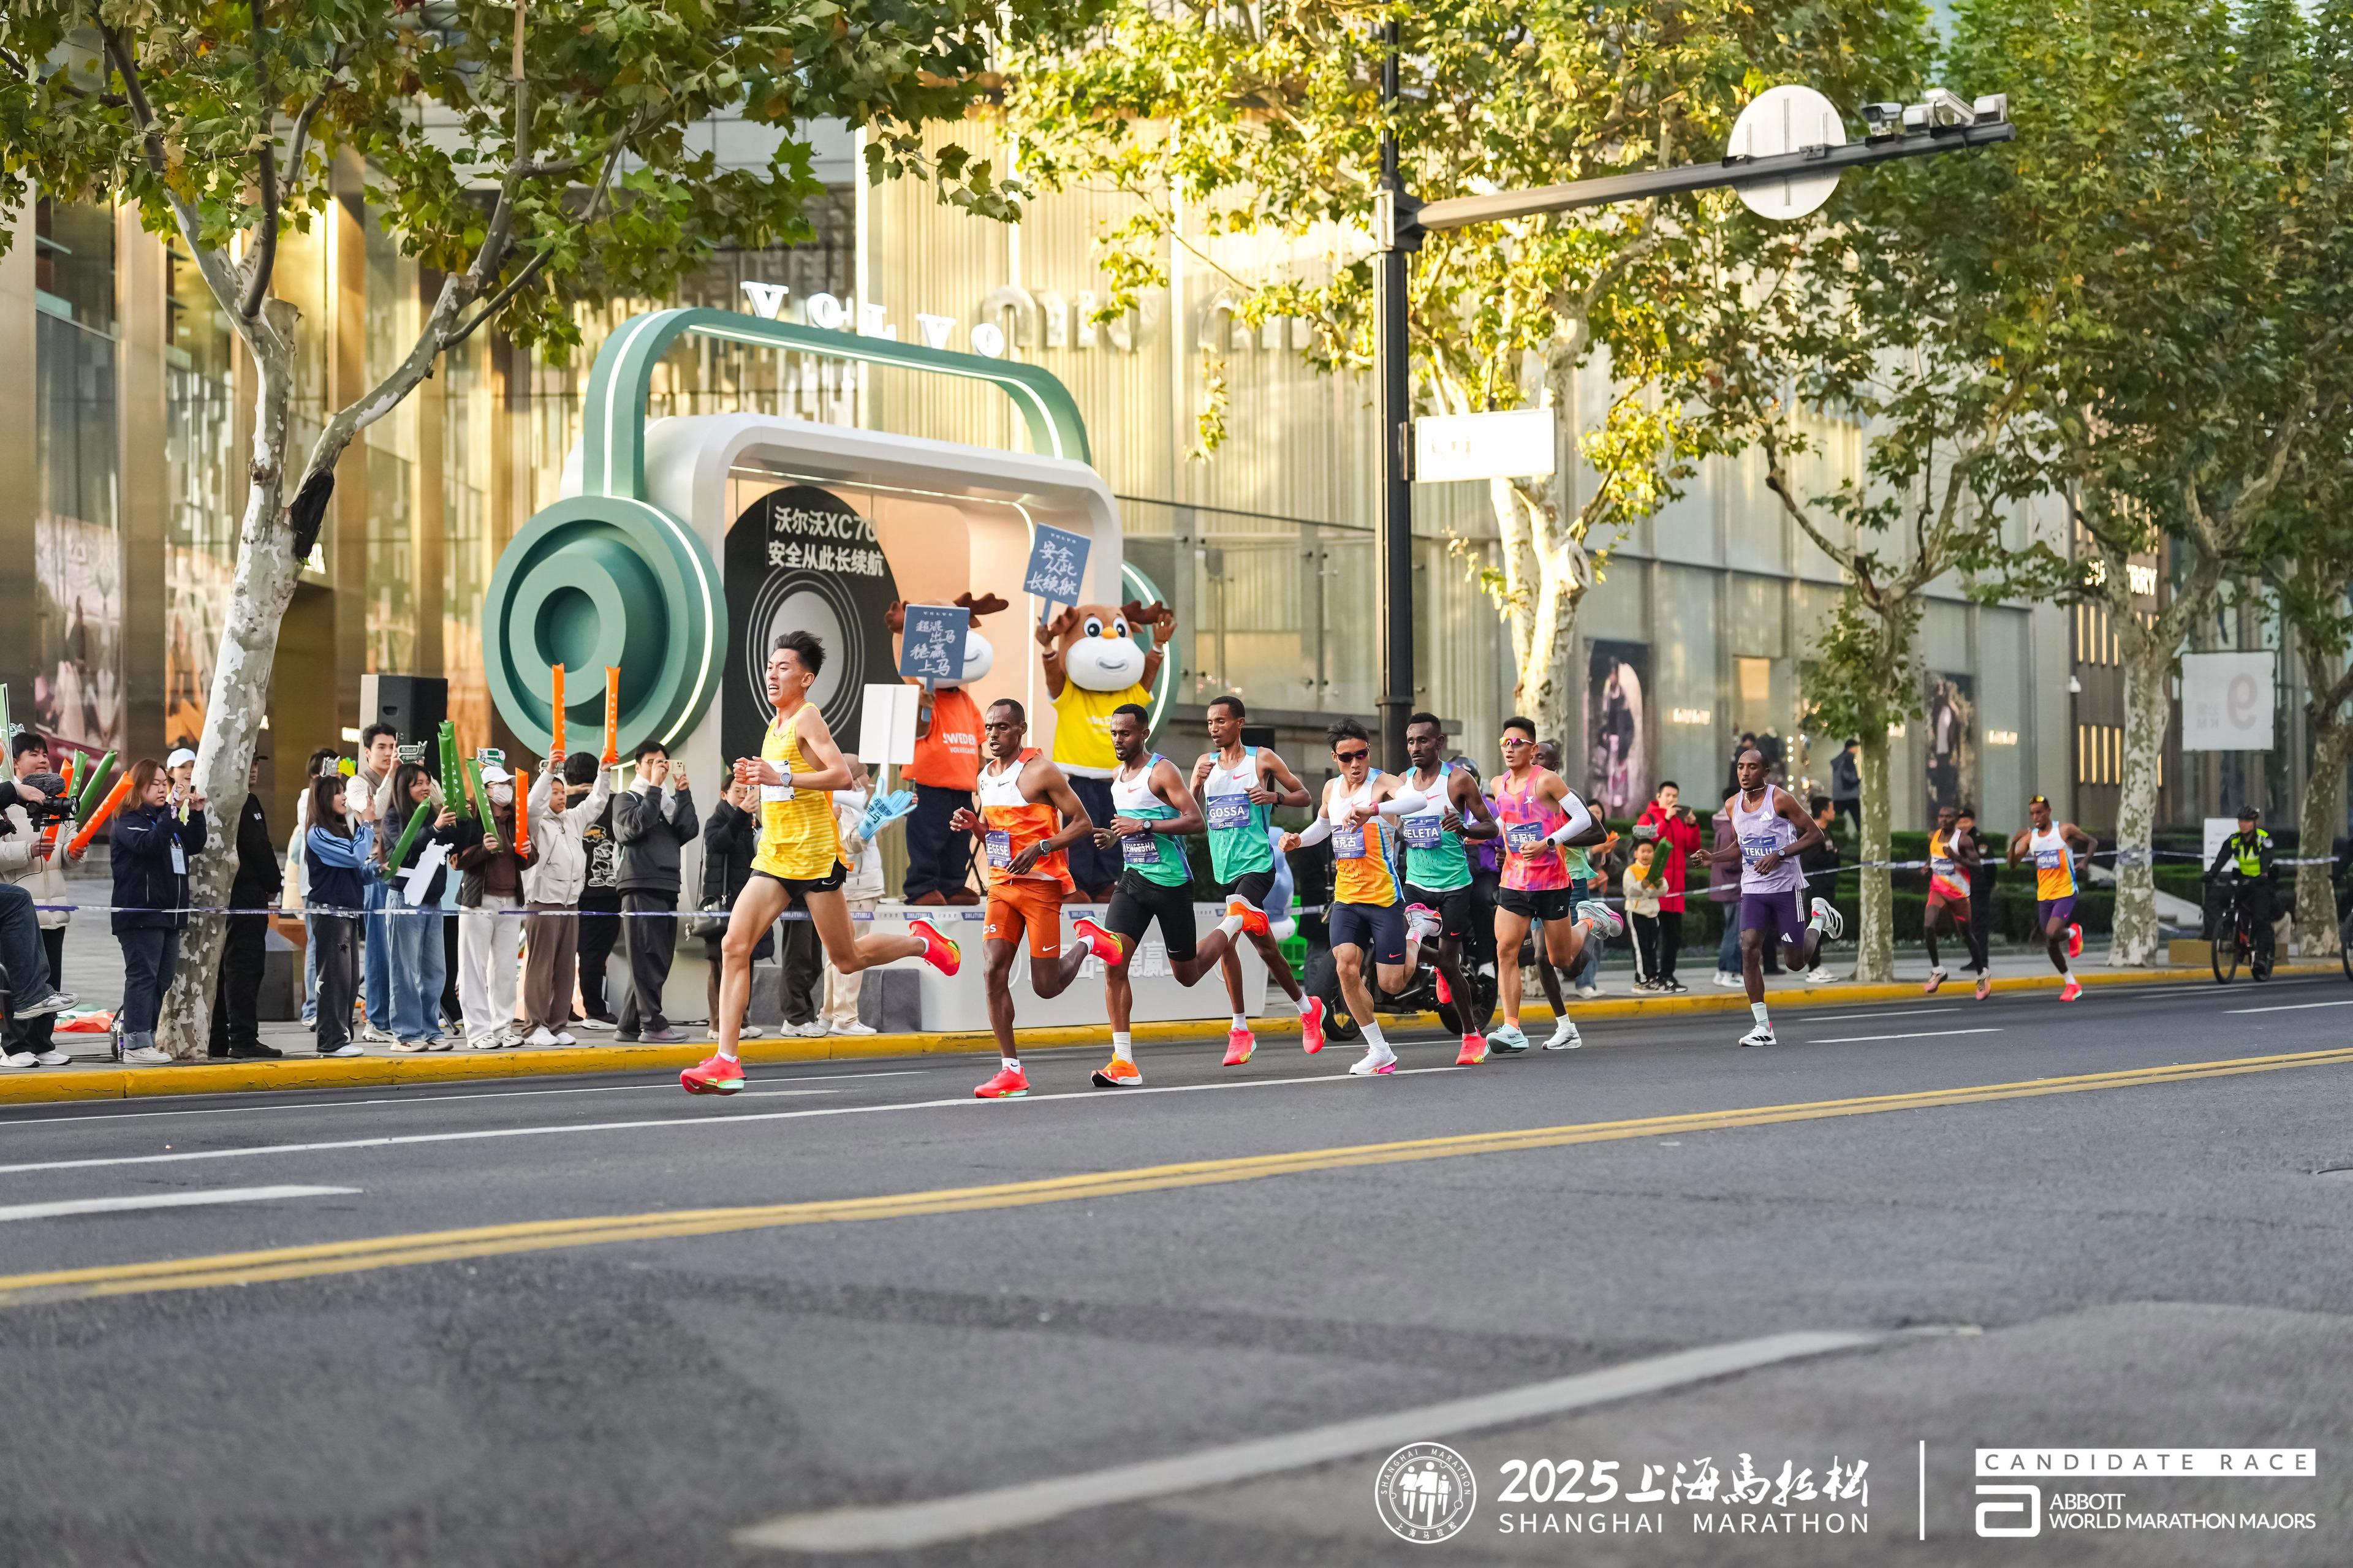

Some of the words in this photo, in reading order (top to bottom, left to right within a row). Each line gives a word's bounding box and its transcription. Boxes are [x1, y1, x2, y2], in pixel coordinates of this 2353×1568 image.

[740, 281, 1004, 358] VOLVO
[775, 506, 877, 542] 沃尔沃XC70
[768, 540, 884, 577] 安全从此长续航
[1039, 540, 1074, 562] 安全
[1045, 559, 1077, 576] 从此
[1027, 571, 1078, 596] 长续航
[930, 629, 955, 643] 出马
[918, 658, 950, 676] 上马
[1209, 806, 1245, 818] GOSSA
[1403, 827, 1439, 838] GELETA
[987, 843, 1009, 855] EGESE
[1745, 847, 1772, 856] TEKLU
